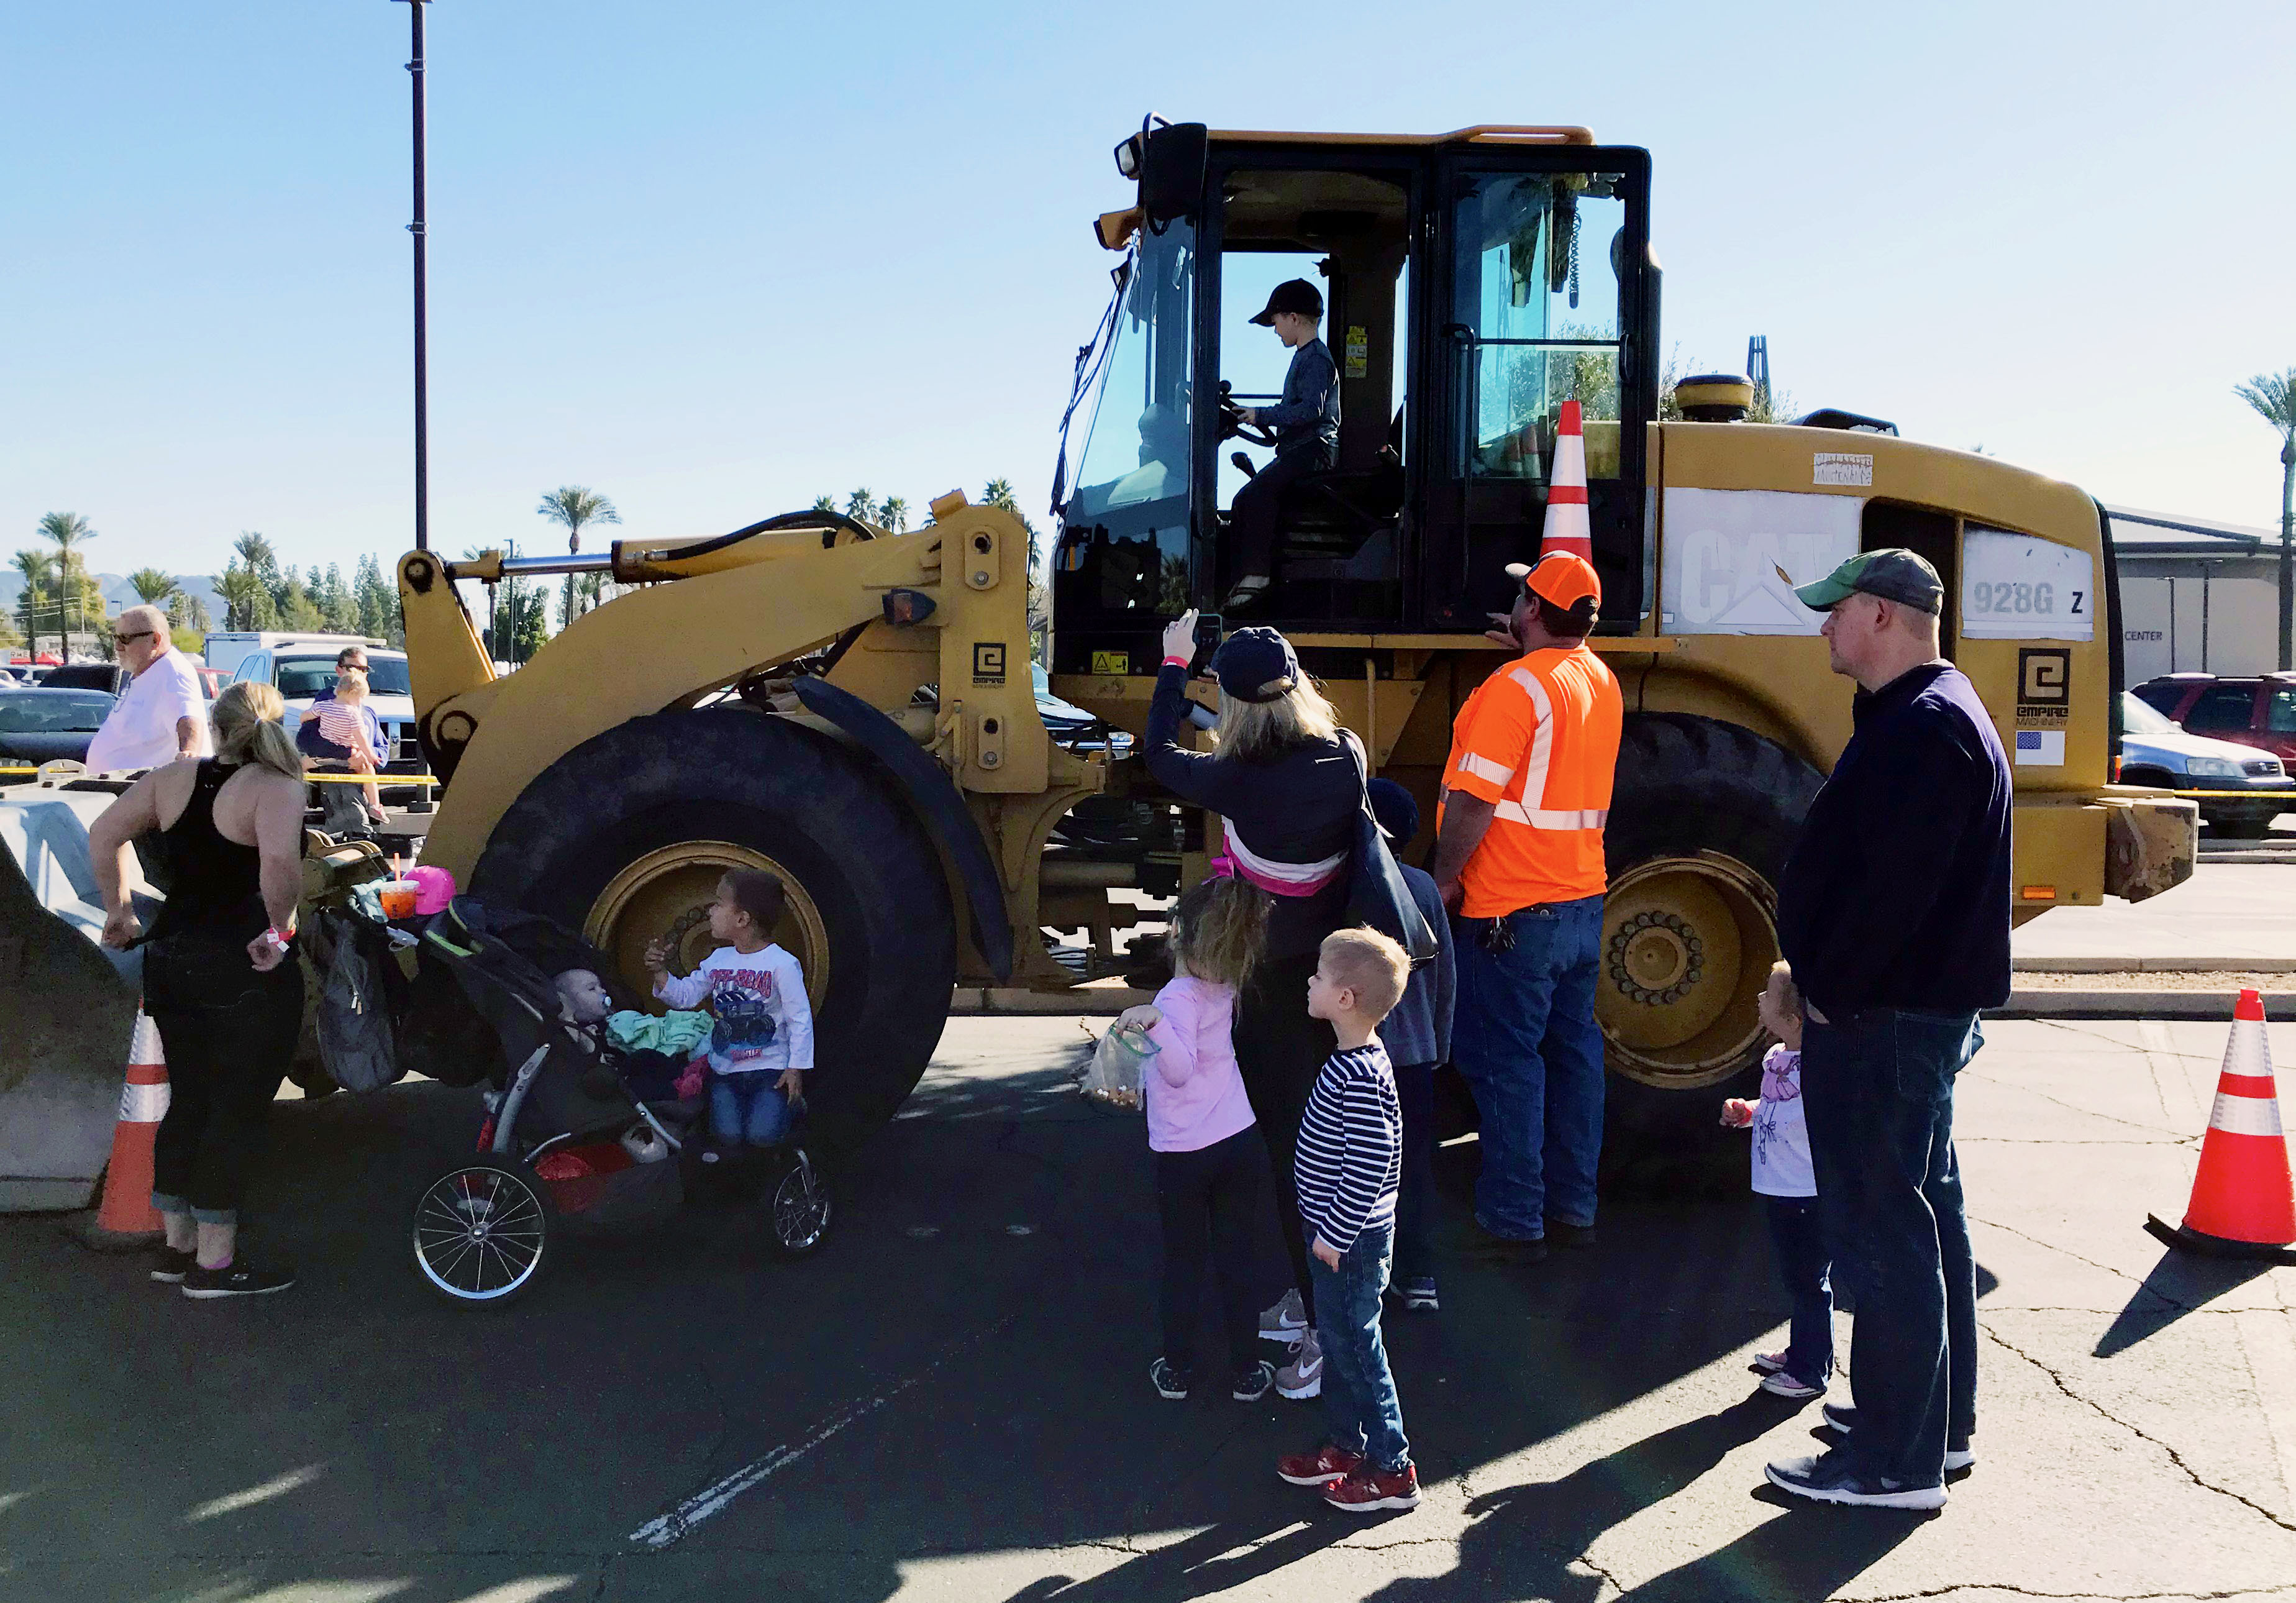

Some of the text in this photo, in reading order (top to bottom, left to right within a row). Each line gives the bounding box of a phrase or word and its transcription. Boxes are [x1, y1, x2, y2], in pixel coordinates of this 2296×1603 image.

[1974, 581, 2084, 614] 928G Z
[2125, 631, 2162, 641] CENTER
